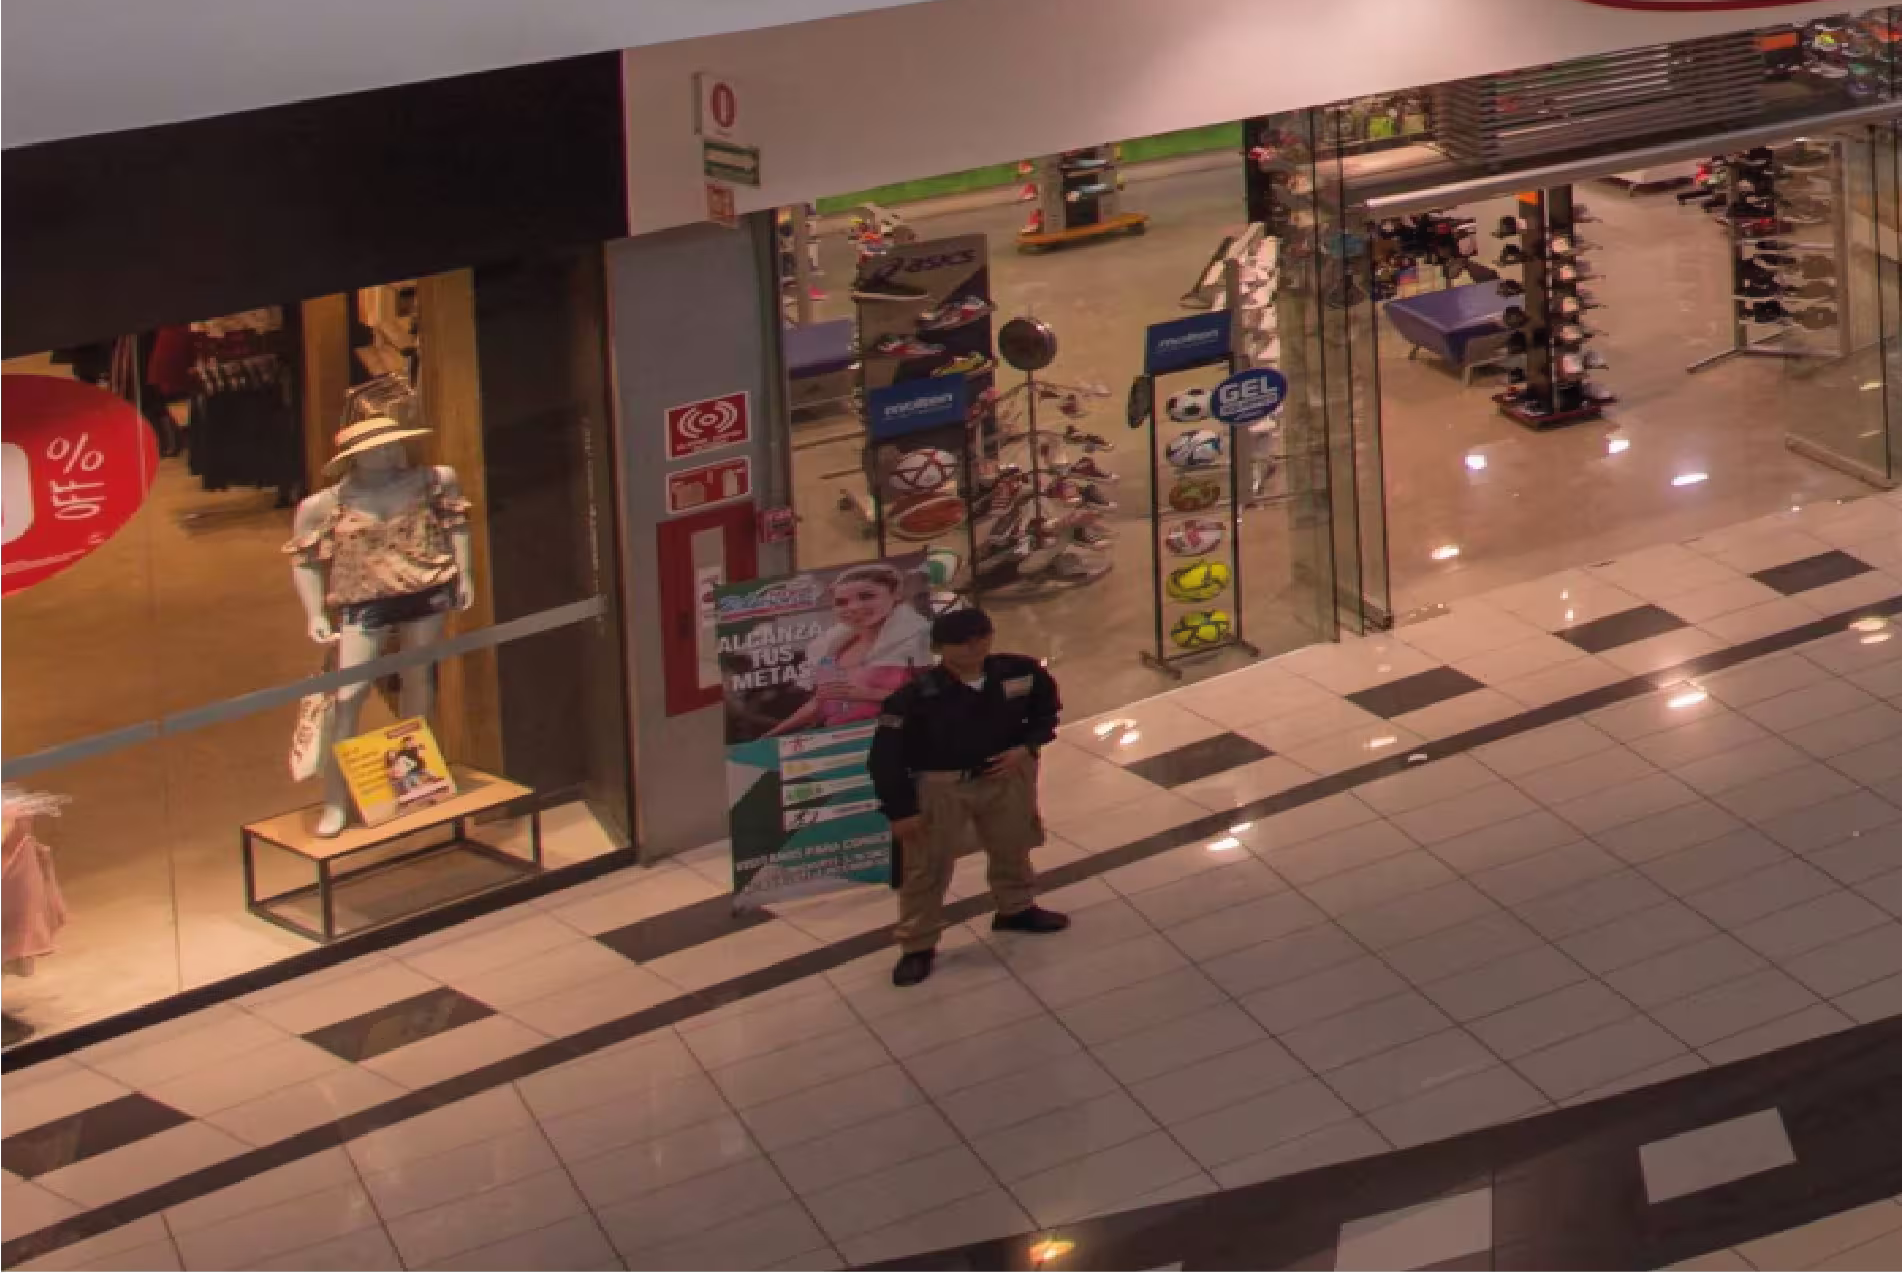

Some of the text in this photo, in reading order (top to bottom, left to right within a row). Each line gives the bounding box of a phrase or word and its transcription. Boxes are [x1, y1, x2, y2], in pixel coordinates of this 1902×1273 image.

[1219, 375, 1278, 404] GEL
[51, 479, 106, 521] OFF
[720, 620, 823, 653] ALCANZA
[750, 642, 796, 668] TUS
[731, 662, 815, 692] METAS
